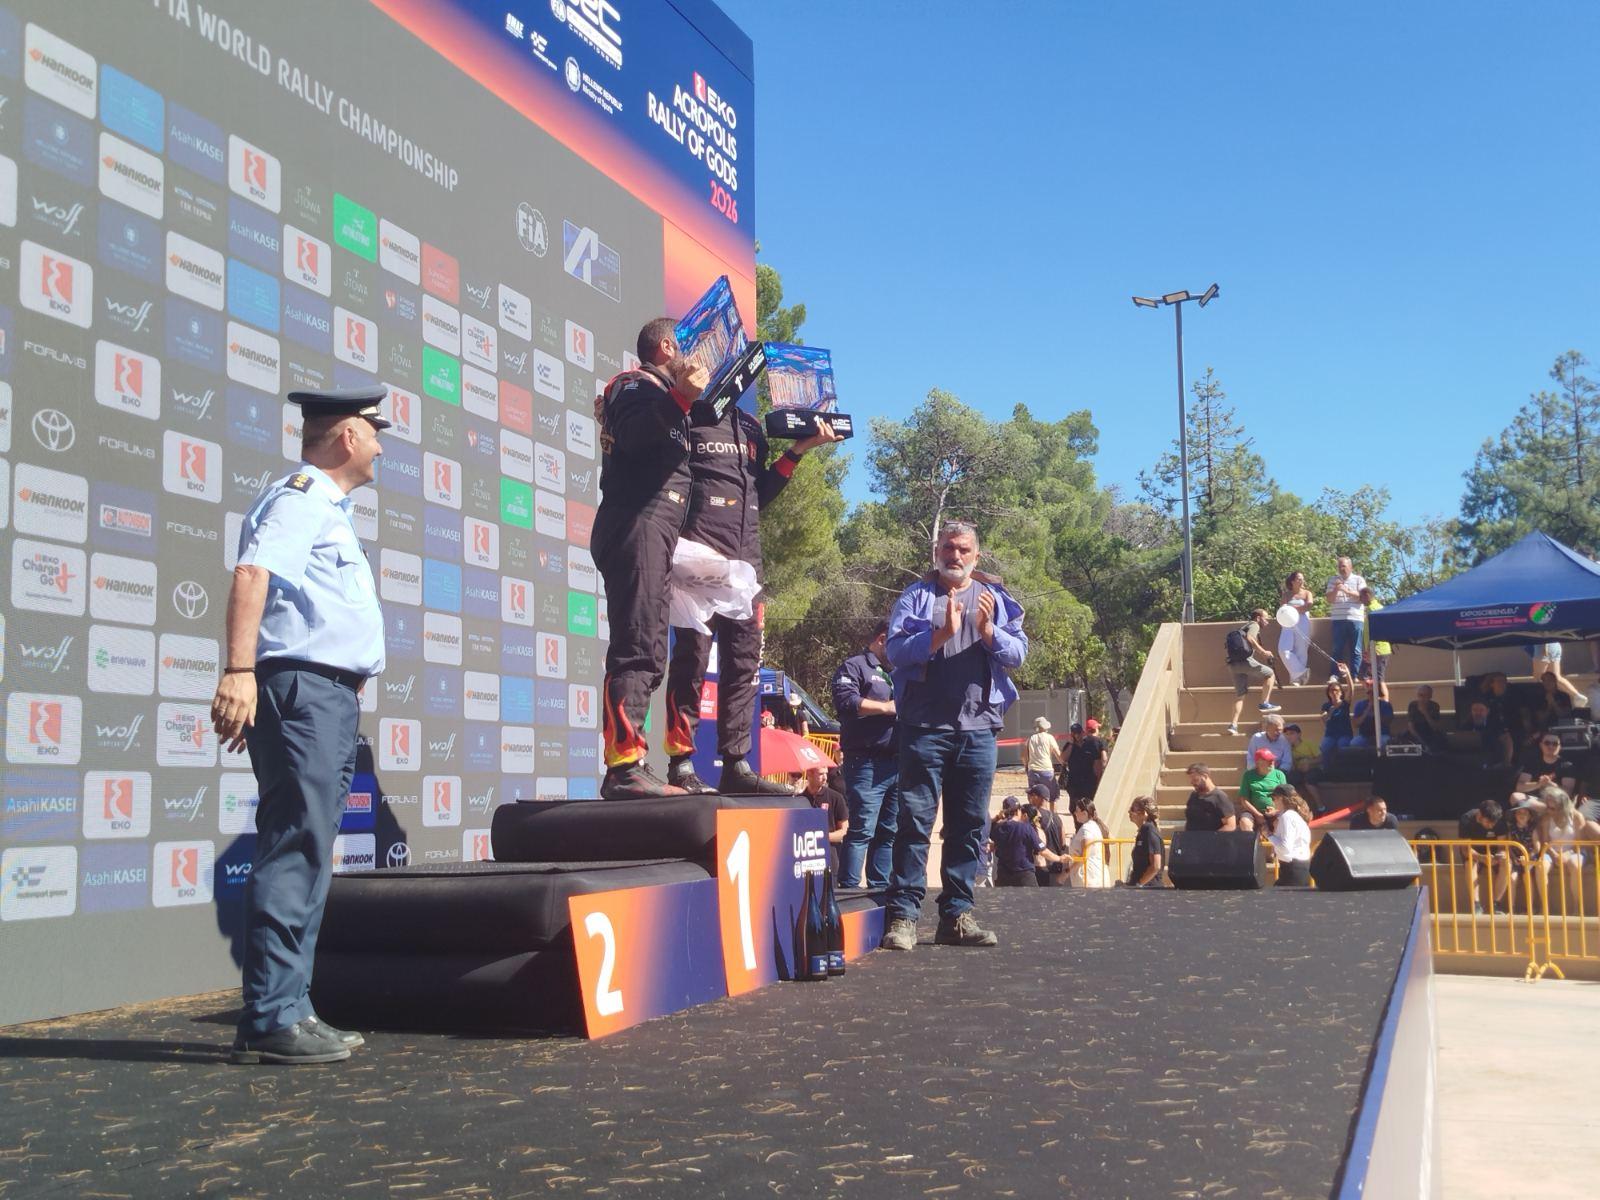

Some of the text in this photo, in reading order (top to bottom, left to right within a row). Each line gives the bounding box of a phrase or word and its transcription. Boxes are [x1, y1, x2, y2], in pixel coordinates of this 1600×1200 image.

[154, 0, 459, 192] IA WORLD RALLY CHAMPIONSHIP
[706, 86, 737, 129] EKO
[673, 84, 737, 161] ACROPOLIS
[170, 125, 224, 163] AsahiKASEI
[648, 91, 738, 192] RALLY OF GODS
[249, 186, 266, 200] EKO
[711, 179, 738, 224] 2026
[231, 219, 280, 254] AsahiKASEI
[303, 272, 318, 286] EKO
[49, 299, 72, 315] EKO
[285, 303, 330, 334] AsahiKASEI
[351, 351, 365, 363] EKO
[121, 395, 141, 408] EKO
[381, 455, 420, 478] AsahiKASEI
[187, 480, 205, 492] EKO
[22, 558, 60, 576] Charge
[40, 573, 54, 586] Go
[110, 654, 147, 667] enerwave
[165, 720, 196, 733] Charge
[179, 732, 192, 742] Go
[37, 745, 60, 756] EKO
[6, 797, 77, 814] AsahiKASEI
[110, 820, 132, 830] EKO
[793, 830, 826, 858] WRC
[84, 869, 147, 886] AsahiKASEI
[178, 888, 196, 898] EKO
[726, 830, 757, 970] 1
[585, 911, 624, 1016] 2
